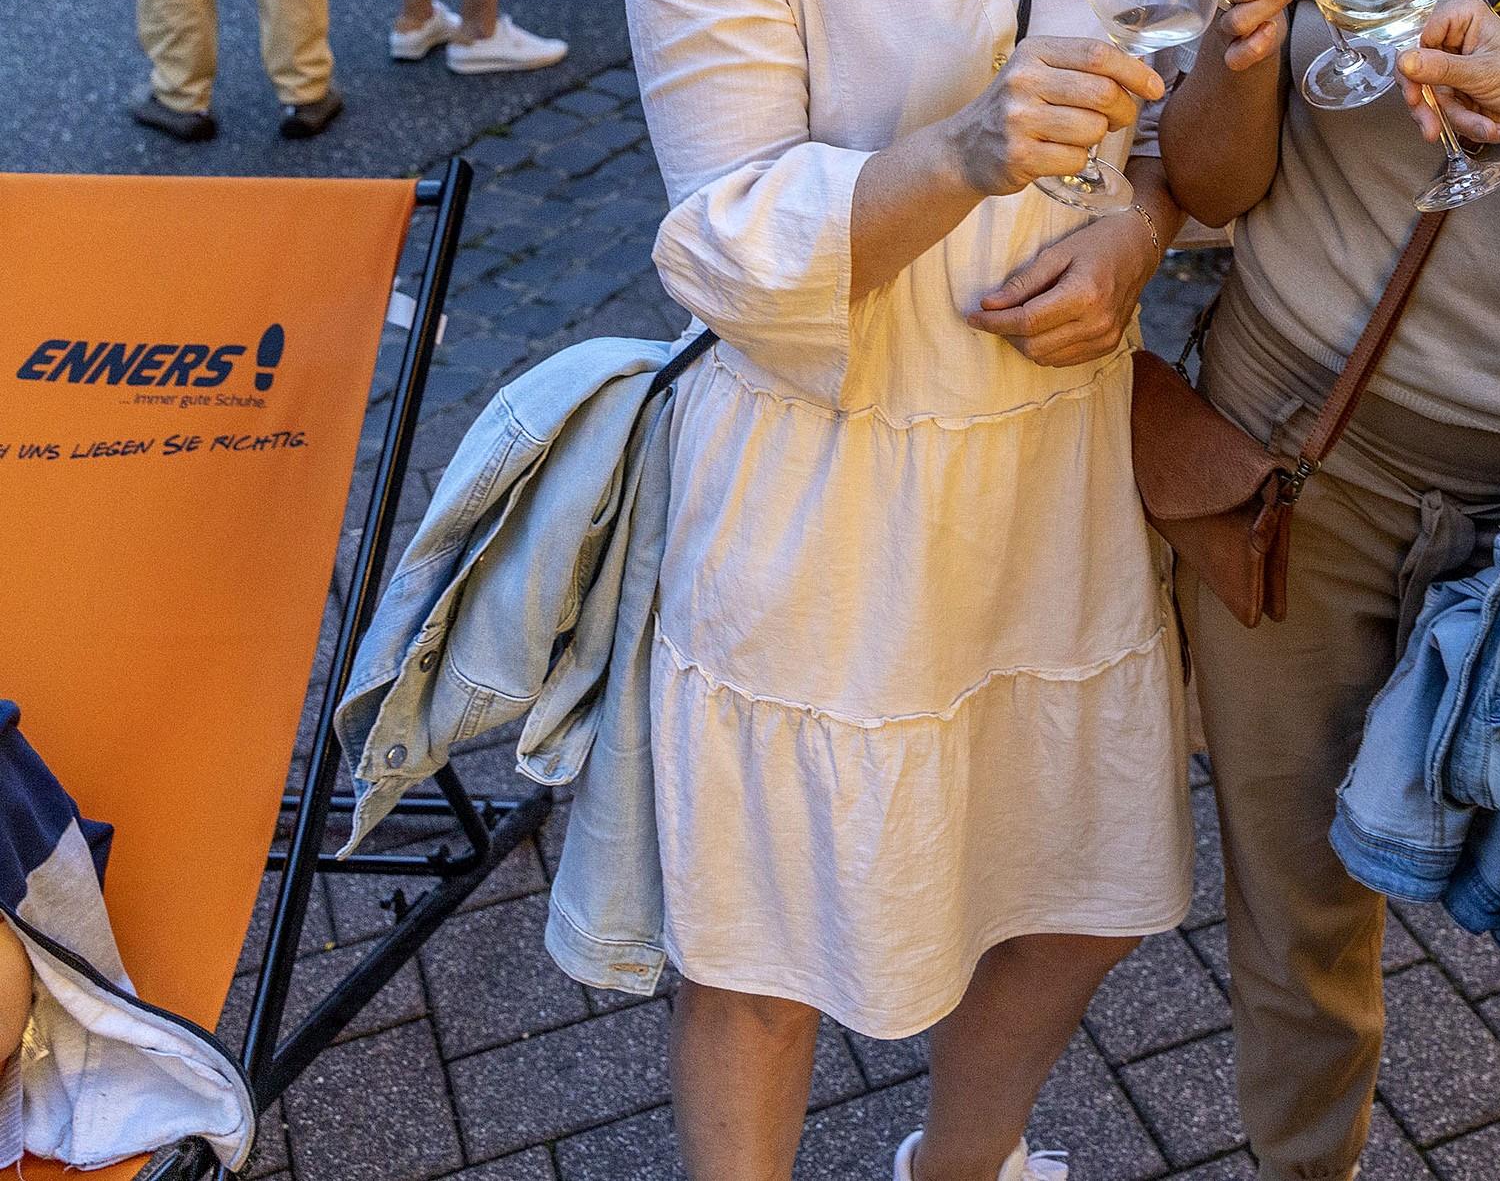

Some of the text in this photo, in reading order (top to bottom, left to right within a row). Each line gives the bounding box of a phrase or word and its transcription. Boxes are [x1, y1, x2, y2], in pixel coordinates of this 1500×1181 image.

[134, 393, 175, 405] immer
[180, 394, 211, 409] gute
[18, 443, 60, 460] UNS
[70, 438, 156, 460] LIEGEN
[162, 433, 203, 456] SIE
